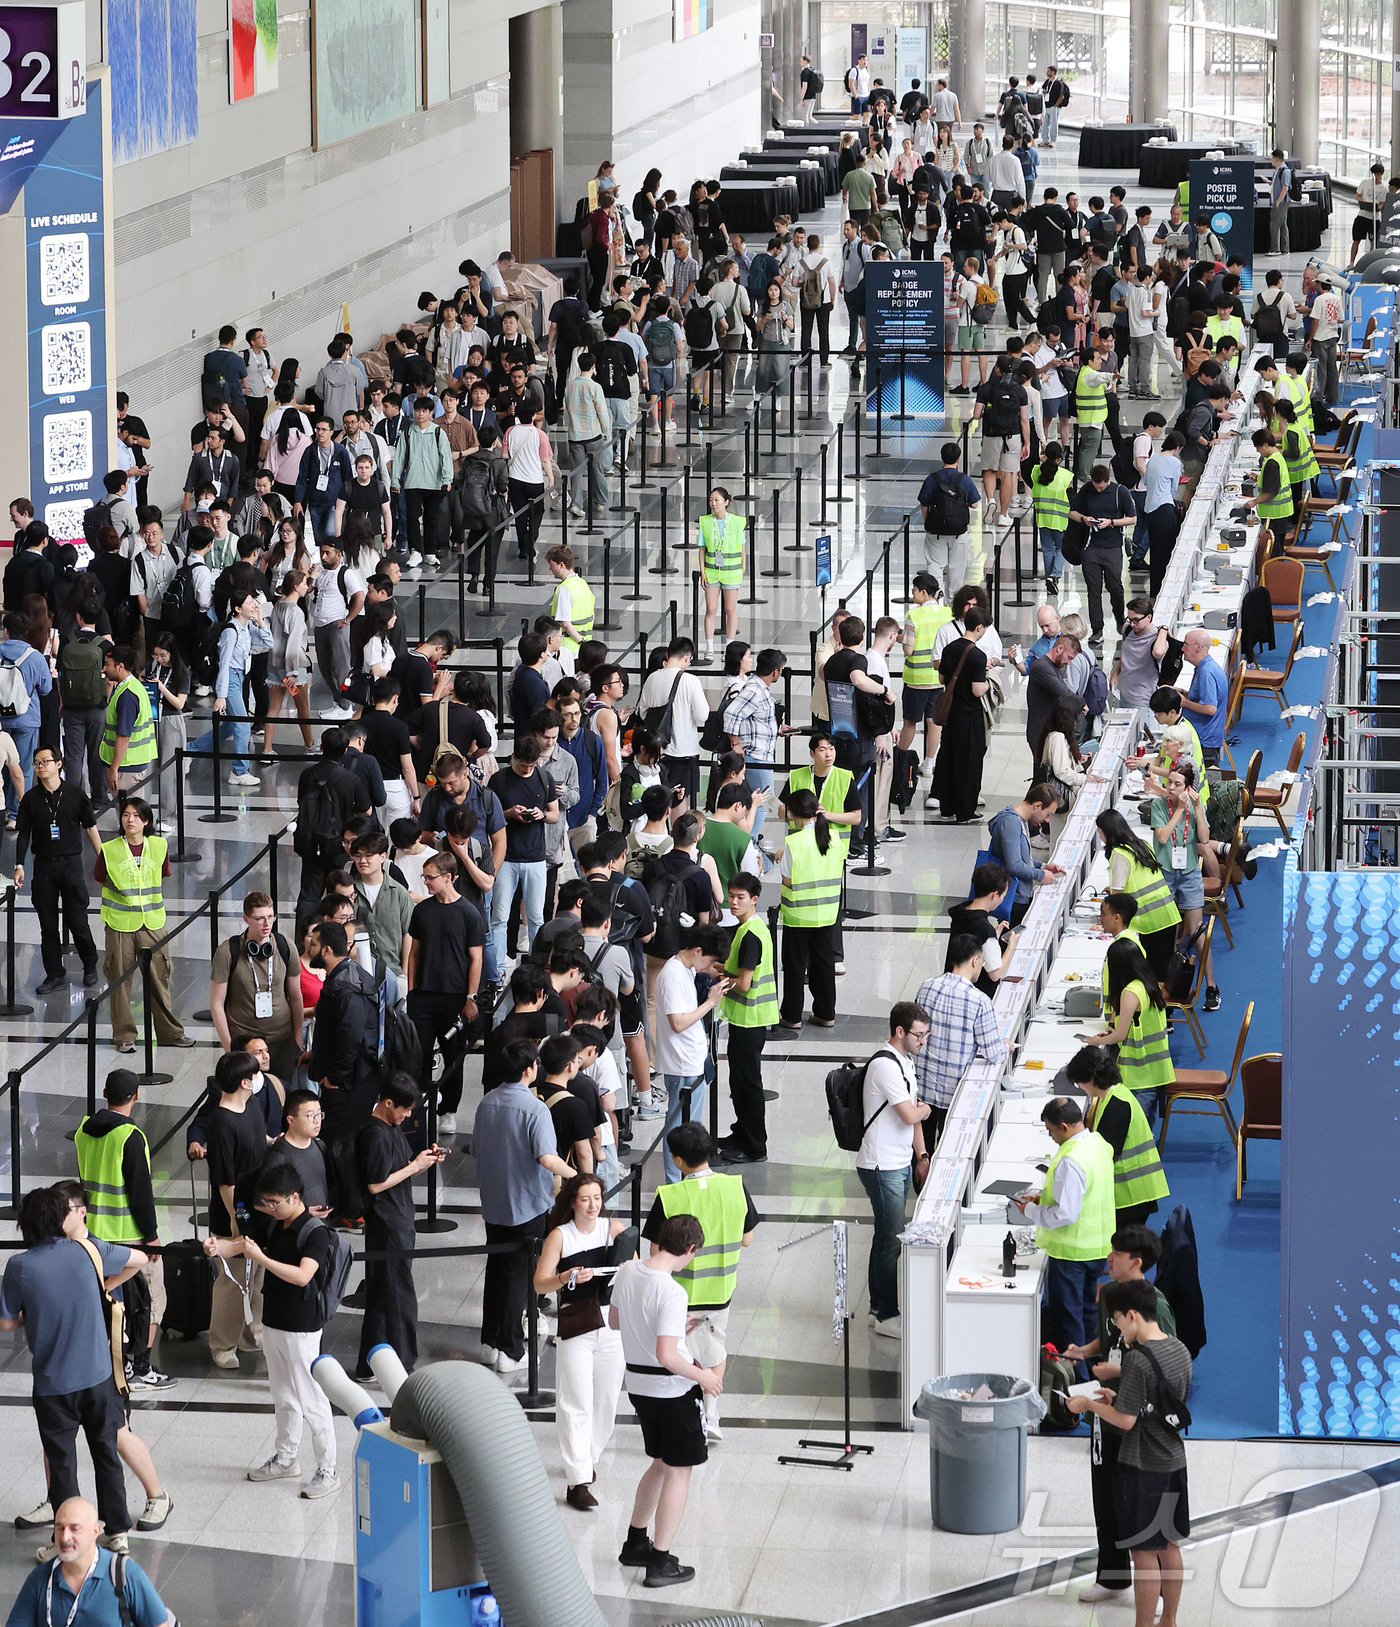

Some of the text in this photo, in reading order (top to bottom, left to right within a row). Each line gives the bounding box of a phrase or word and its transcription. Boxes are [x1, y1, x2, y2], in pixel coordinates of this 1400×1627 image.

[72, 60, 84, 108] B2
[1206, 184, 1237, 193] POSTER
[1206, 194, 1237, 203] PICK UP
[30, 212, 98, 228] LIVE SCHEDULE
[892, 280, 918, 289] BADGE
[877, 290, 933, 298] REPLACEMENT
[891, 299, 919, 308] POLICY
[54, 306, 77, 316] ROOM
[58, 394, 76, 404] WEB
[49, 482, 89, 495] APP STORE
